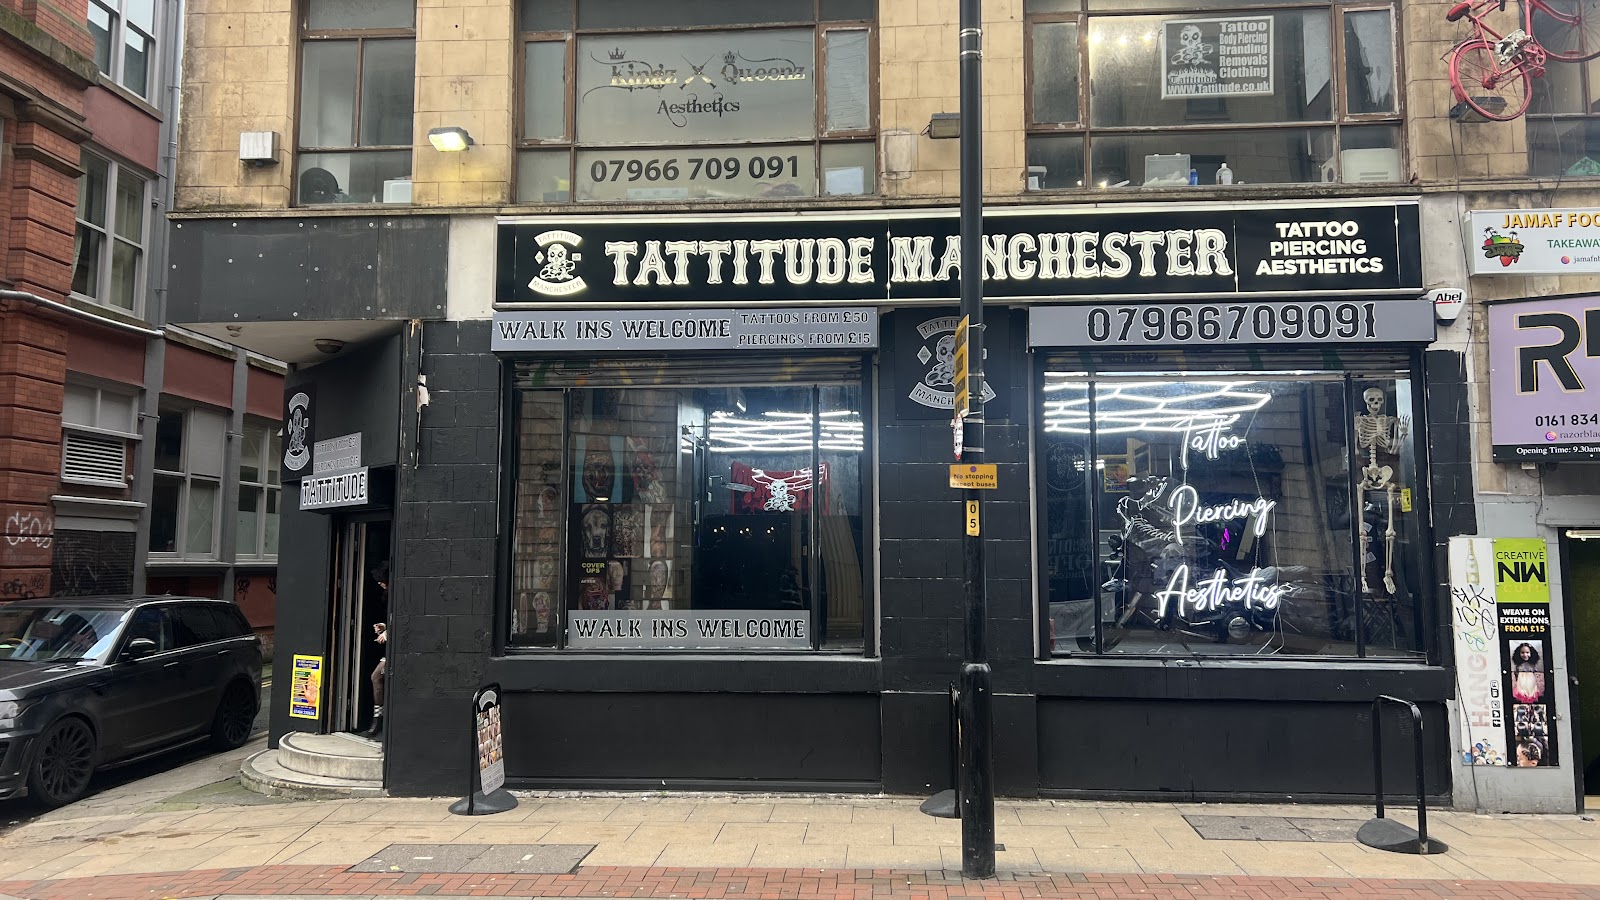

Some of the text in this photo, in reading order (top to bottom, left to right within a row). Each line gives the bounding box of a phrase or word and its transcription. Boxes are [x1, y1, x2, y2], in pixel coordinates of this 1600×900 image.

[1220, 22, 1267, 33] Tattoo
[1219, 32, 1268, 45] Body Piercing
[1219, 44, 1268, 55] Branding
[1219, 54, 1268, 67] Removals
[1219, 67, 1268, 78] Clothing
[657, 94, 740, 121] Aesthetics
[590, 155, 799, 182] 07966 709 091
[1502, 213, 1562, 229] JAMAF
[1275, 220, 1359, 238] TATTOO
[537, 232, 579, 244] TATTITUDE
[1547, 239, 1600, 249] TAKEAWA
[1270, 239, 1367, 256] PIERCING
[604, 228, 1234, 285] TATTITUDE MANCHESTER
[1255, 257, 1384, 275] AESTHETICS
[531, 280, 583, 294] MANCHESTER
[1435, 292, 1462, 303] Abel
[741, 311, 868, 325] TATTOOS FROM £50
[1086, 302, 1377, 342] 07966709091
[498, 319, 732, 340] WALK INS WELCOME
[739, 332, 870, 345] PIERCINGS FROM £15
[1535, 413, 1599, 427] 0161 834
[1172, 416, 1246, 471] Tattoo
[1516, 445, 1600, 456] Opening Time: 9.30am
[302, 471, 366, 505] TATTITUDE
[970, 504, 976, 514] 0
[1170, 485, 1277, 547] Piercing
[970, 518, 976, 528] 5
[1496, 551, 1544, 560] CREATIVE
[1497, 562, 1546, 582] NW
[1152, 564, 1284, 618] Aesthetics
[1502, 608, 1545, 616] WEAVE ON
[573, 617, 806, 639] WALK INS WELCOME
